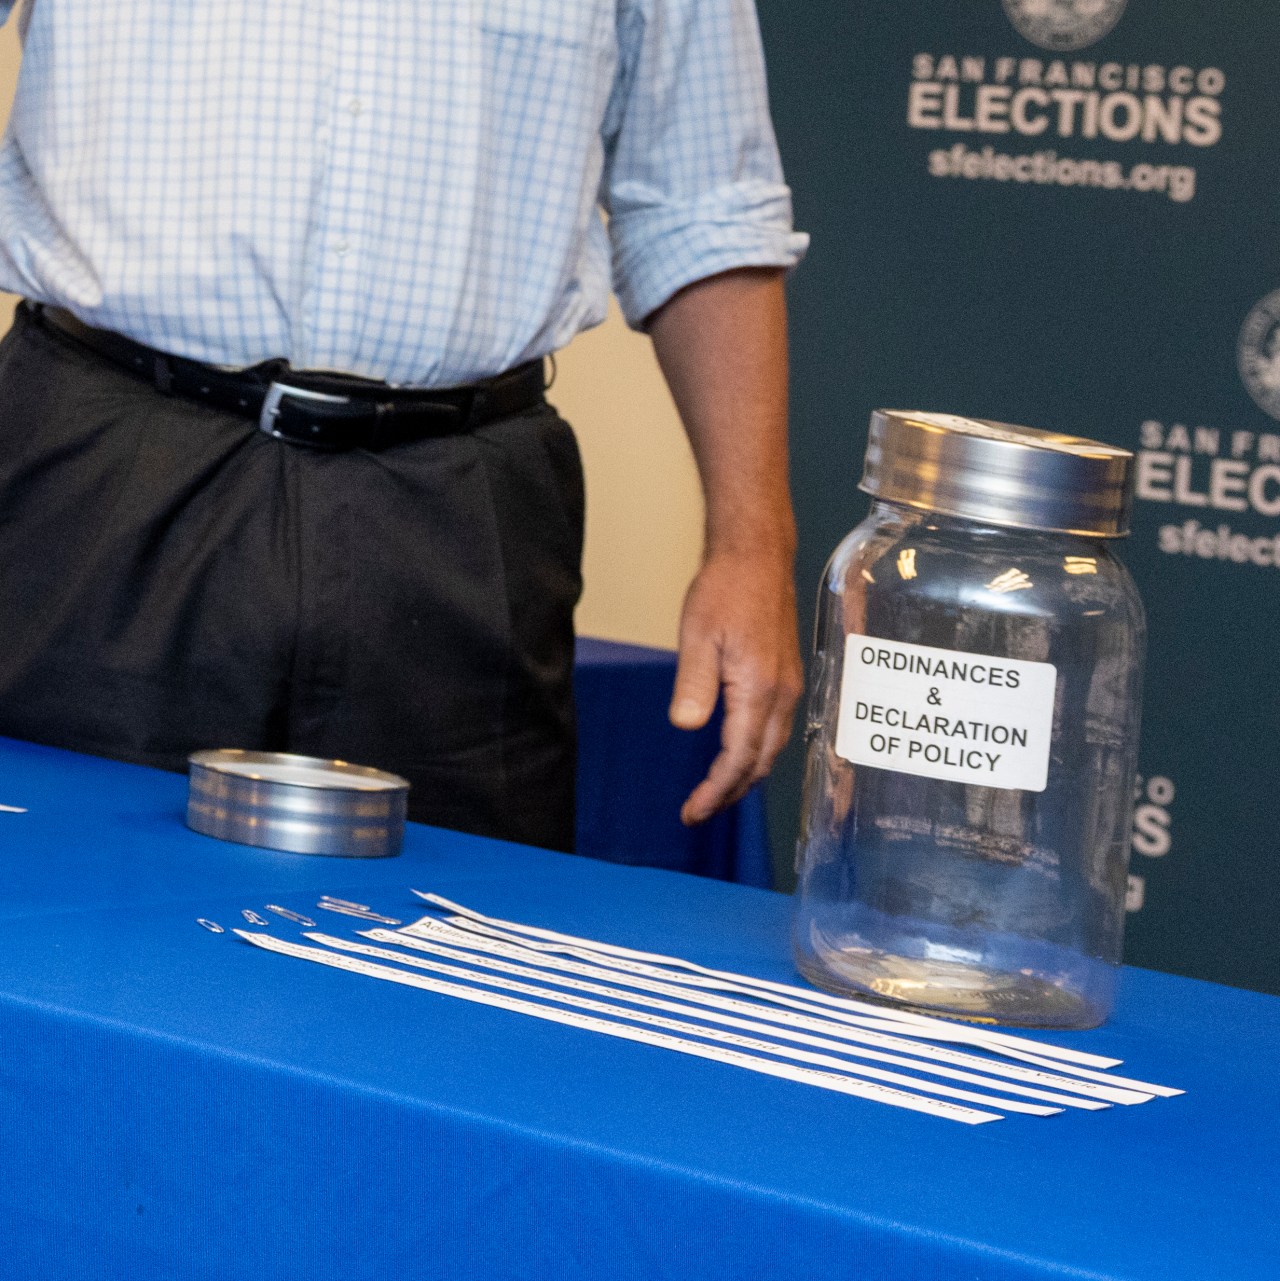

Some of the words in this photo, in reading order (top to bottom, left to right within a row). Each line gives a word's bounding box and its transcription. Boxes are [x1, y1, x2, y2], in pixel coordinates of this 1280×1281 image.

[912, 53, 985, 83] SAN
[995, 58, 1226, 96] FRANCISCO
[907, 81, 1223, 148] ELECTIONS
[928, 144, 1197, 203] sfelections.org
[1140, 419, 1220, 457] SAN
[861, 646, 1021, 688] ORDINANCES
[927, 687, 942, 706] &
[855, 701, 1028, 747] DECLARATION
[870, 734, 901, 755] OF
[908, 740, 1002, 771] POLICY
[723, 1032, 779, 1052] Fund
[1036, 1070, 1096, 1090] Vehicle
[928, 1099, 974, 1115] Open
